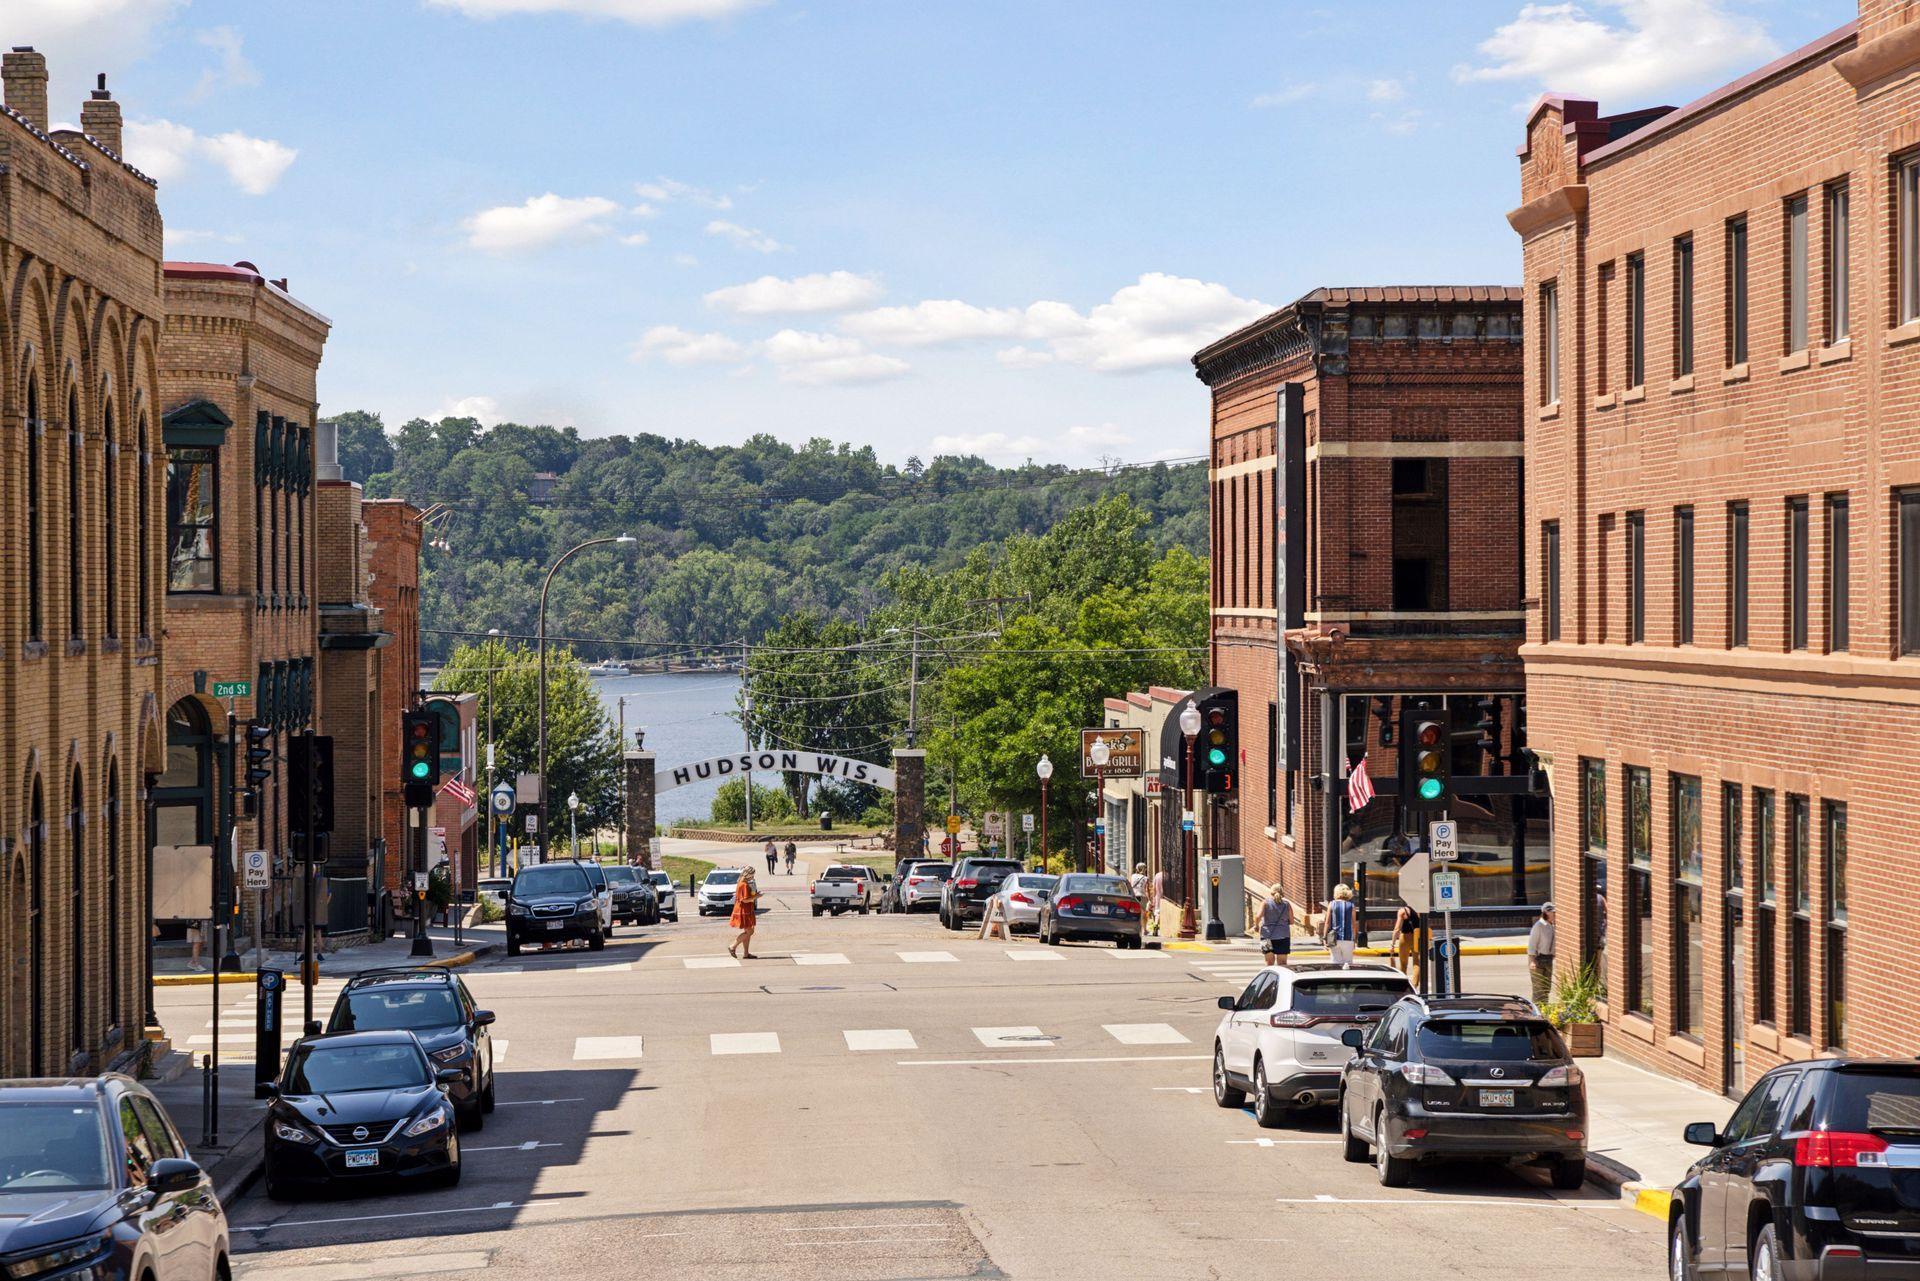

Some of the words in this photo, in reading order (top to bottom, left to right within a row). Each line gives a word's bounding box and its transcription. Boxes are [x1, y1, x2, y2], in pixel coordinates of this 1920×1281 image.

[218, 685, 234, 695] 2nd
[237, 684, 246, 694] St
[1112, 756, 1139, 767] GRILL
[674, 754, 797, 785] HUDSON
[817, 756, 877, 784] WIS.
[1147, 783, 1161, 792] AT
[942, 843, 959, 853] STP
[1435, 840, 1452, 848] Pay
[248, 869, 264, 877] Pay
